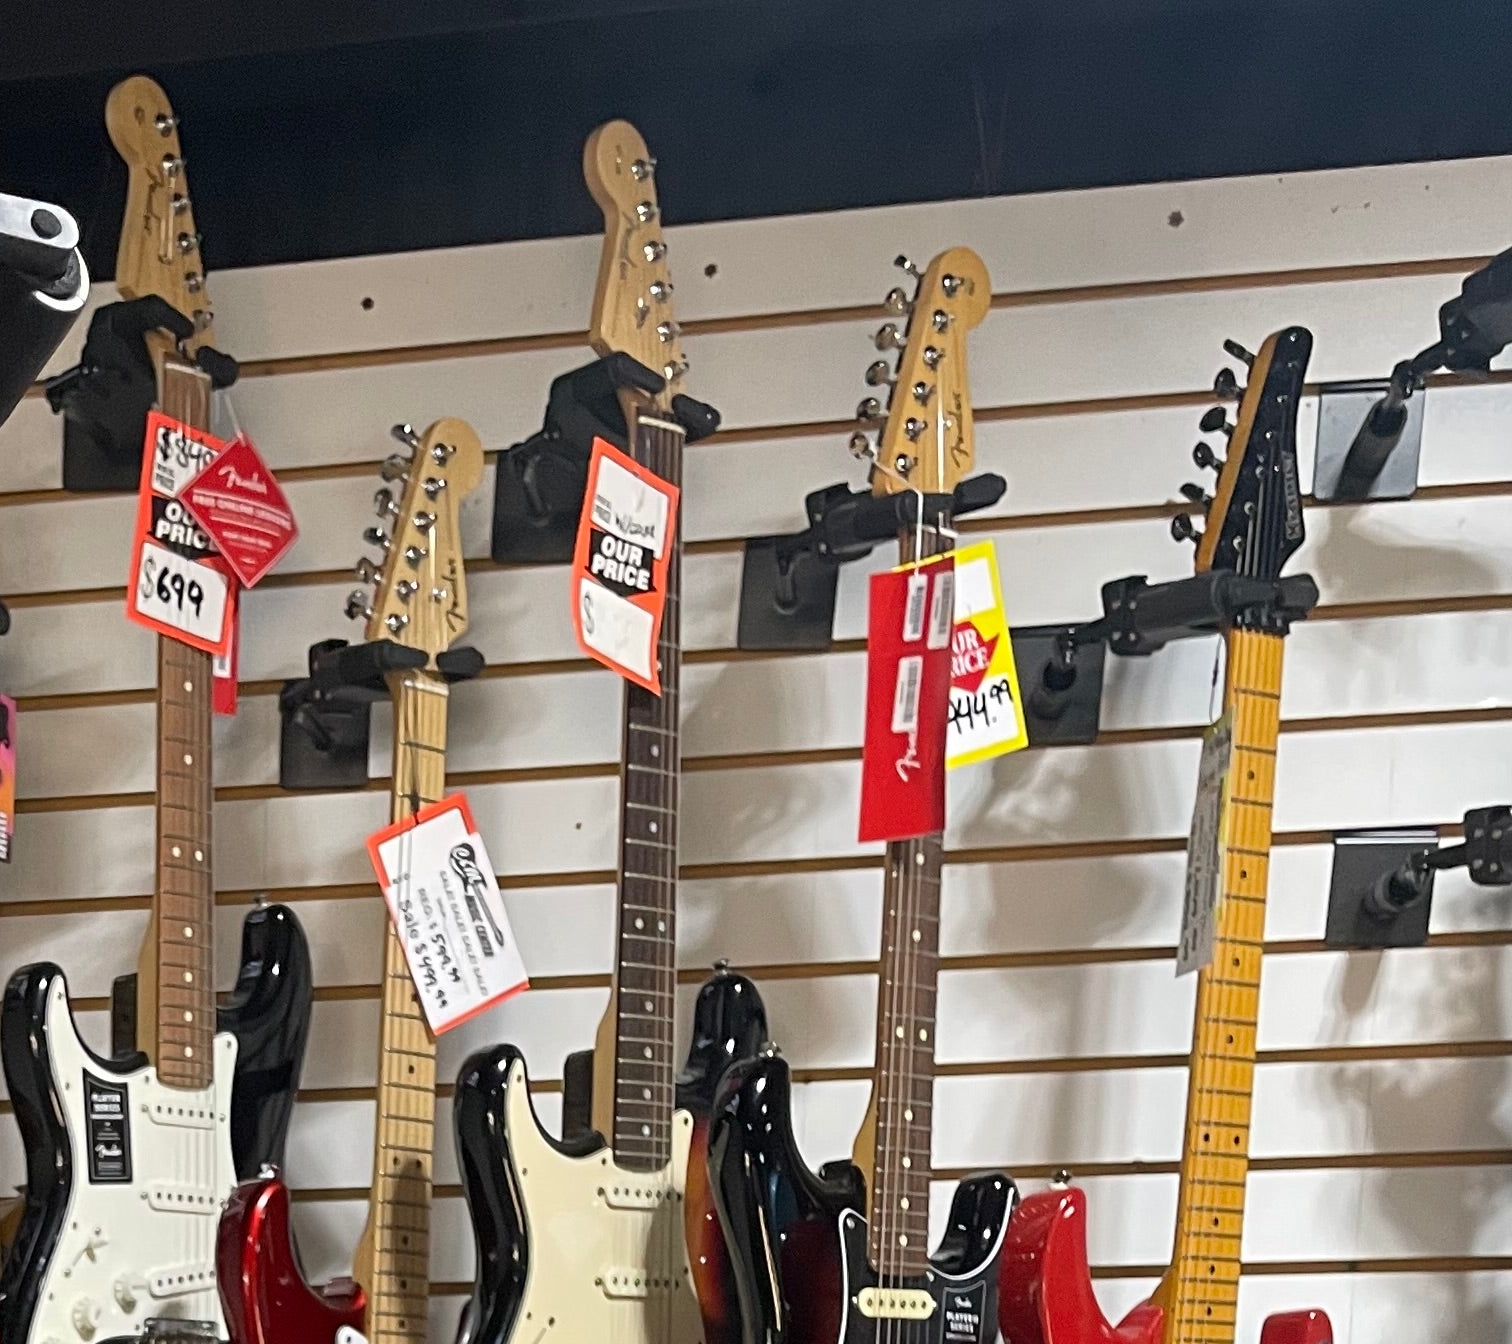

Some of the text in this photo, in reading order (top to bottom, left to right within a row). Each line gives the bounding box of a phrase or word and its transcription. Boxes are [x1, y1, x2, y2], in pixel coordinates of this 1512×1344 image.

[600, 534, 644, 567] OUR
[139, 555, 204, 619] $699
[590, 552, 651, 592] PRICE
[951, 628, 980, 655] UR
[950, 647, 992, 679] RICE
